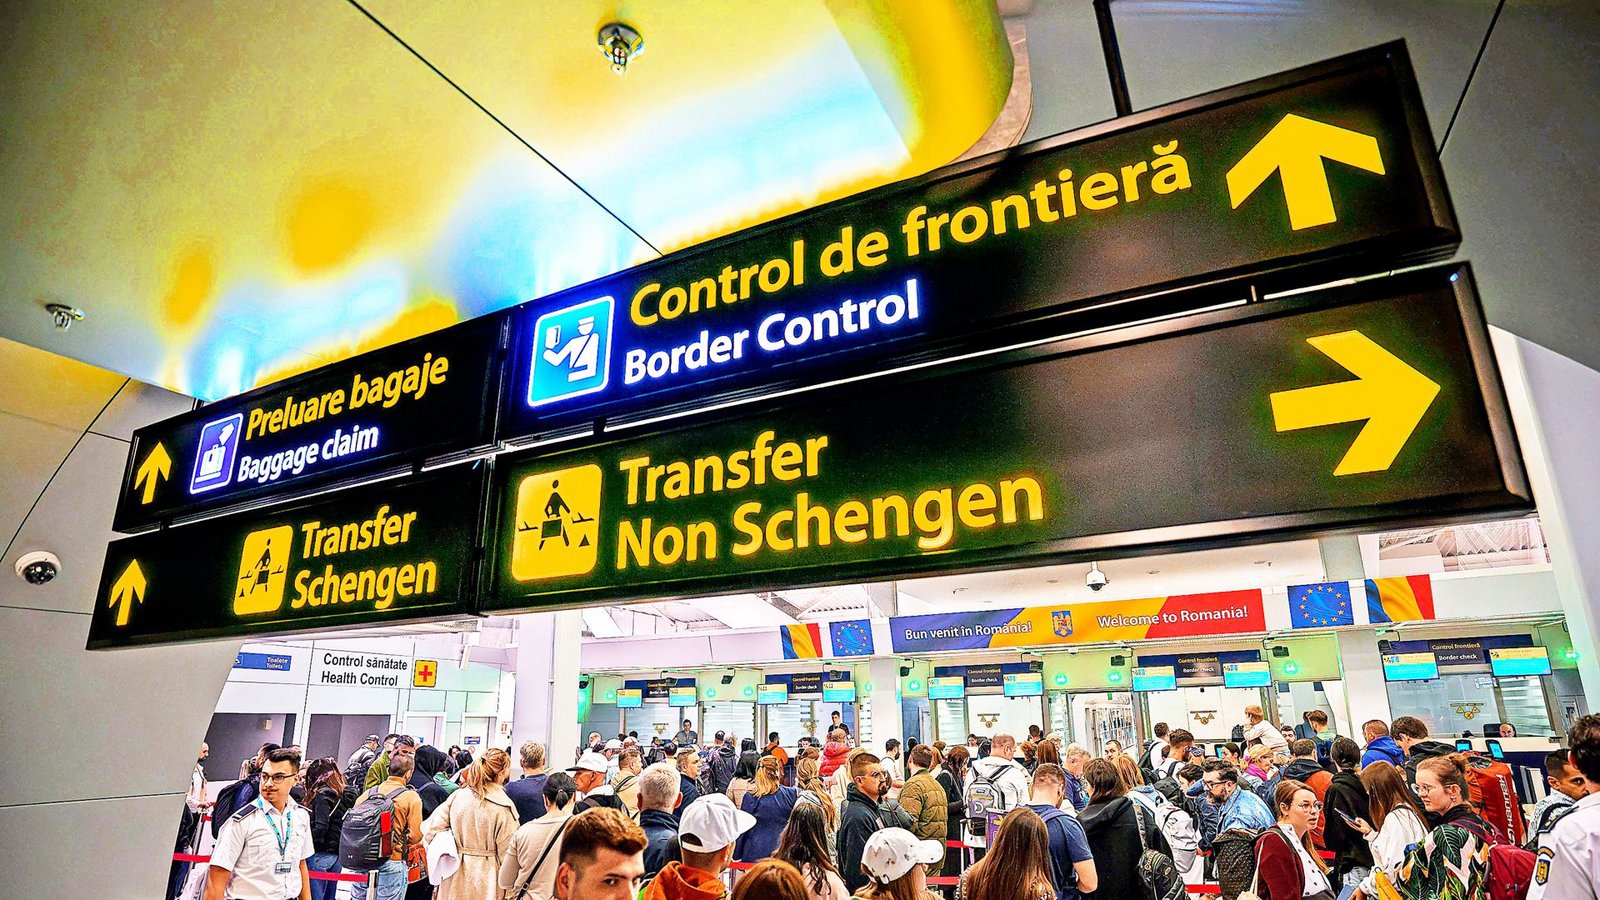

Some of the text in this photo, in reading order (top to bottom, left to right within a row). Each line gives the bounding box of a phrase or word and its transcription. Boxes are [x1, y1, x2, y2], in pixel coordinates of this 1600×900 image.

[630, 140, 1192, 326] Control de frontieră
[624, 279, 920, 385] Border Control
[245, 352, 449, 440] Preluare bagaje
[237, 425, 379, 483] Baggage claim
[619, 431, 828, 505] Transfer
[301, 505, 417, 559] Transfer
[616, 476, 1044, 570] Non Schengen
[290, 560, 437, 610] Schengen
[905, 621, 1032, 640] Bun venit în România!
[1097, 605, 1249, 628] Welcome to Romania!
[321, 670, 398, 686] Health Control
[323, 652, 408, 670] Control sănătate
